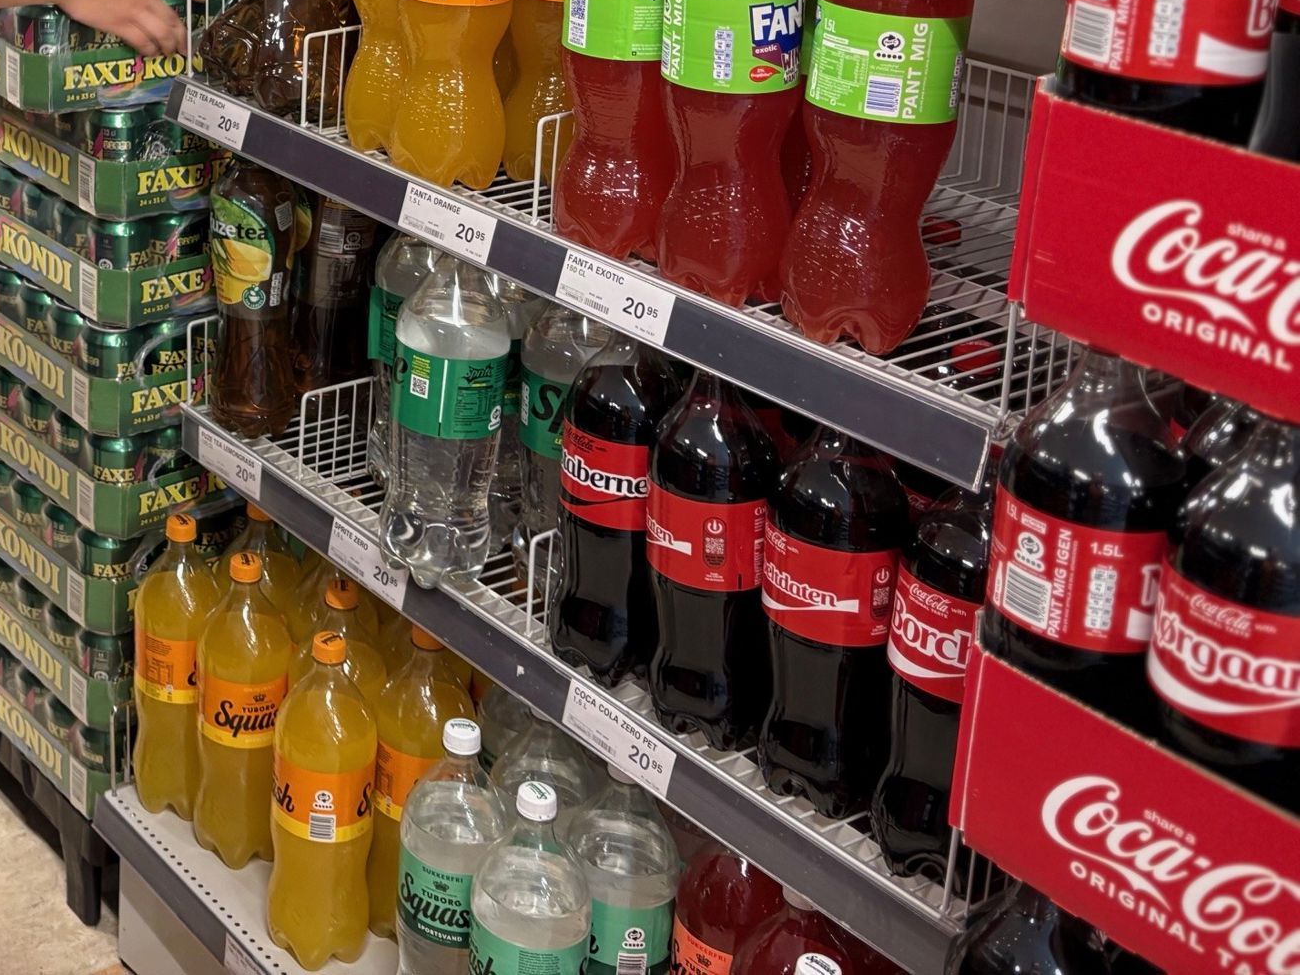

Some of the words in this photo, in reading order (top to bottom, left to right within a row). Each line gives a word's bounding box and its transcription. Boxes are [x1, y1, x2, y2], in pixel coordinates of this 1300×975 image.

[669, 33, 682, 81] PANT
[754, 43, 778, 55] exotic
[1108, 29, 1123, 72] PANT
[63, 58, 135, 91] FAXE
[901, 66, 918, 120] PANT
[910, 22, 929, 62] MIG
[186, 87, 199, 100] FUZE
[199, 93, 209, 104] TEA
[208, 97, 226, 110] PEACH
[3, 118, 71, 186] KONDI
[137, 162, 204, 196] FAXE
[410, 186, 432, 204] FANTA
[432, 197, 462, 216] ORANGE
[1226, 222, 1272, 248] share
[1273, 237, 1287, 252] a
[1, 224, 73, 292] KONDI
[565, 263, 577, 275] 150
[577, 269, 587, 279] CL
[568, 253, 595, 272] FANTA
[595, 265, 625, 286] EXOTIC
[141, 268, 204, 304] FAXE
[1142, 302, 1293, 372] ORIGINAL
[0, 420, 70, 500] KONDI
[213, 438, 223, 450] TEA
[139, 474, 200, 516] FAXE
[334, 521, 353, 543] SPRITE
[352, 533, 369, 552] ZERO
[1056, 528, 1073, 567] IGEN
[1089, 541, 1125, 559] 1.5L
[1054, 562, 1068, 596] MIG
[1047, 596, 1063, 638] PANT
[241, 702, 277, 715] TUBORG
[574, 685, 598, 709] COCA
[597, 703, 620, 725] COLA
[620, 720, 642, 741] ZERO
[642, 736, 658, 753] PET
[1142, 808, 1185, 838] share
[1184, 831, 1197, 845] a
[421, 865, 464, 885] SUKKERFRI
[421, 887, 463, 908] TUBORG
[1069, 860, 1205, 953] ORIGINAL
[417, 922, 463, 944] SPORTSVAND
